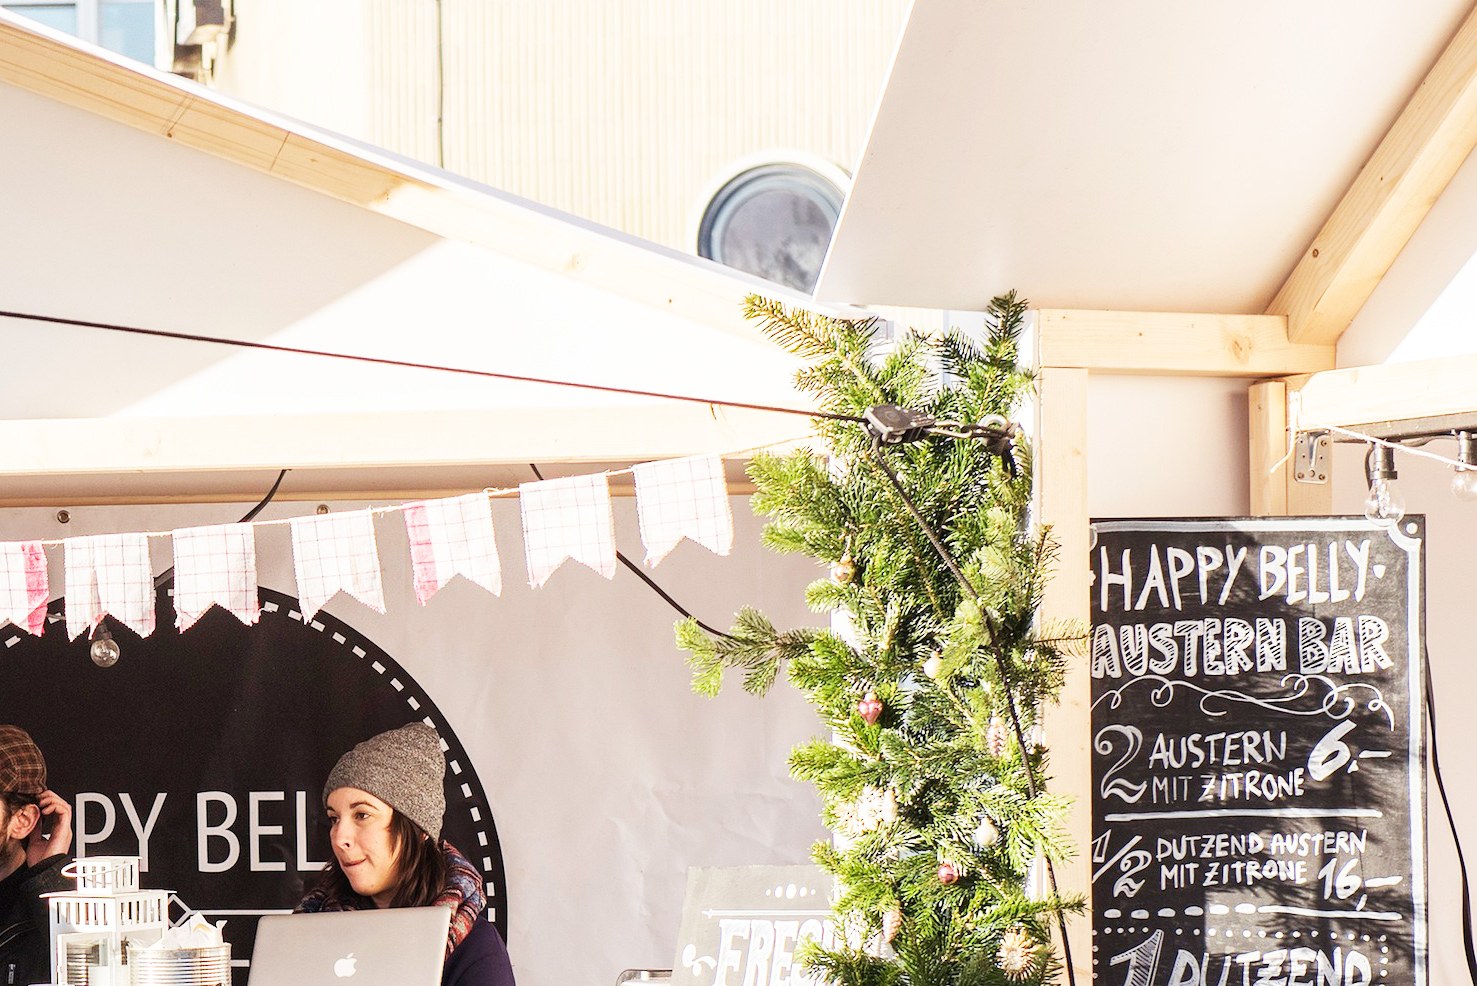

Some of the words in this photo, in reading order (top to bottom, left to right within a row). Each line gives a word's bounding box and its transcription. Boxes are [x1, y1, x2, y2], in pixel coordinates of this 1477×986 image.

[1099, 543, 1248, 612] HAPPY
[1259, 540, 1371, 604] BELLY
[1091, 617, 1287, 679] AUSTERN
[1300, 615, 1394, 675] BAR
[1094, 724, 1148, 803] 2
[1149, 731, 1286, 769] AUSTERN
[1152, 775, 1192, 803] MIT
[1198, 768, 1304, 802] ZITRONE
[196, 791, 328, 873] BEL
[1156, 832, 1263, 862] DUTZEND
[1270, 829, 1367, 856] AUSTERN
[1161, 863, 1199, 890] MIT
[1203, 861, 1307, 886] ZITRONE
